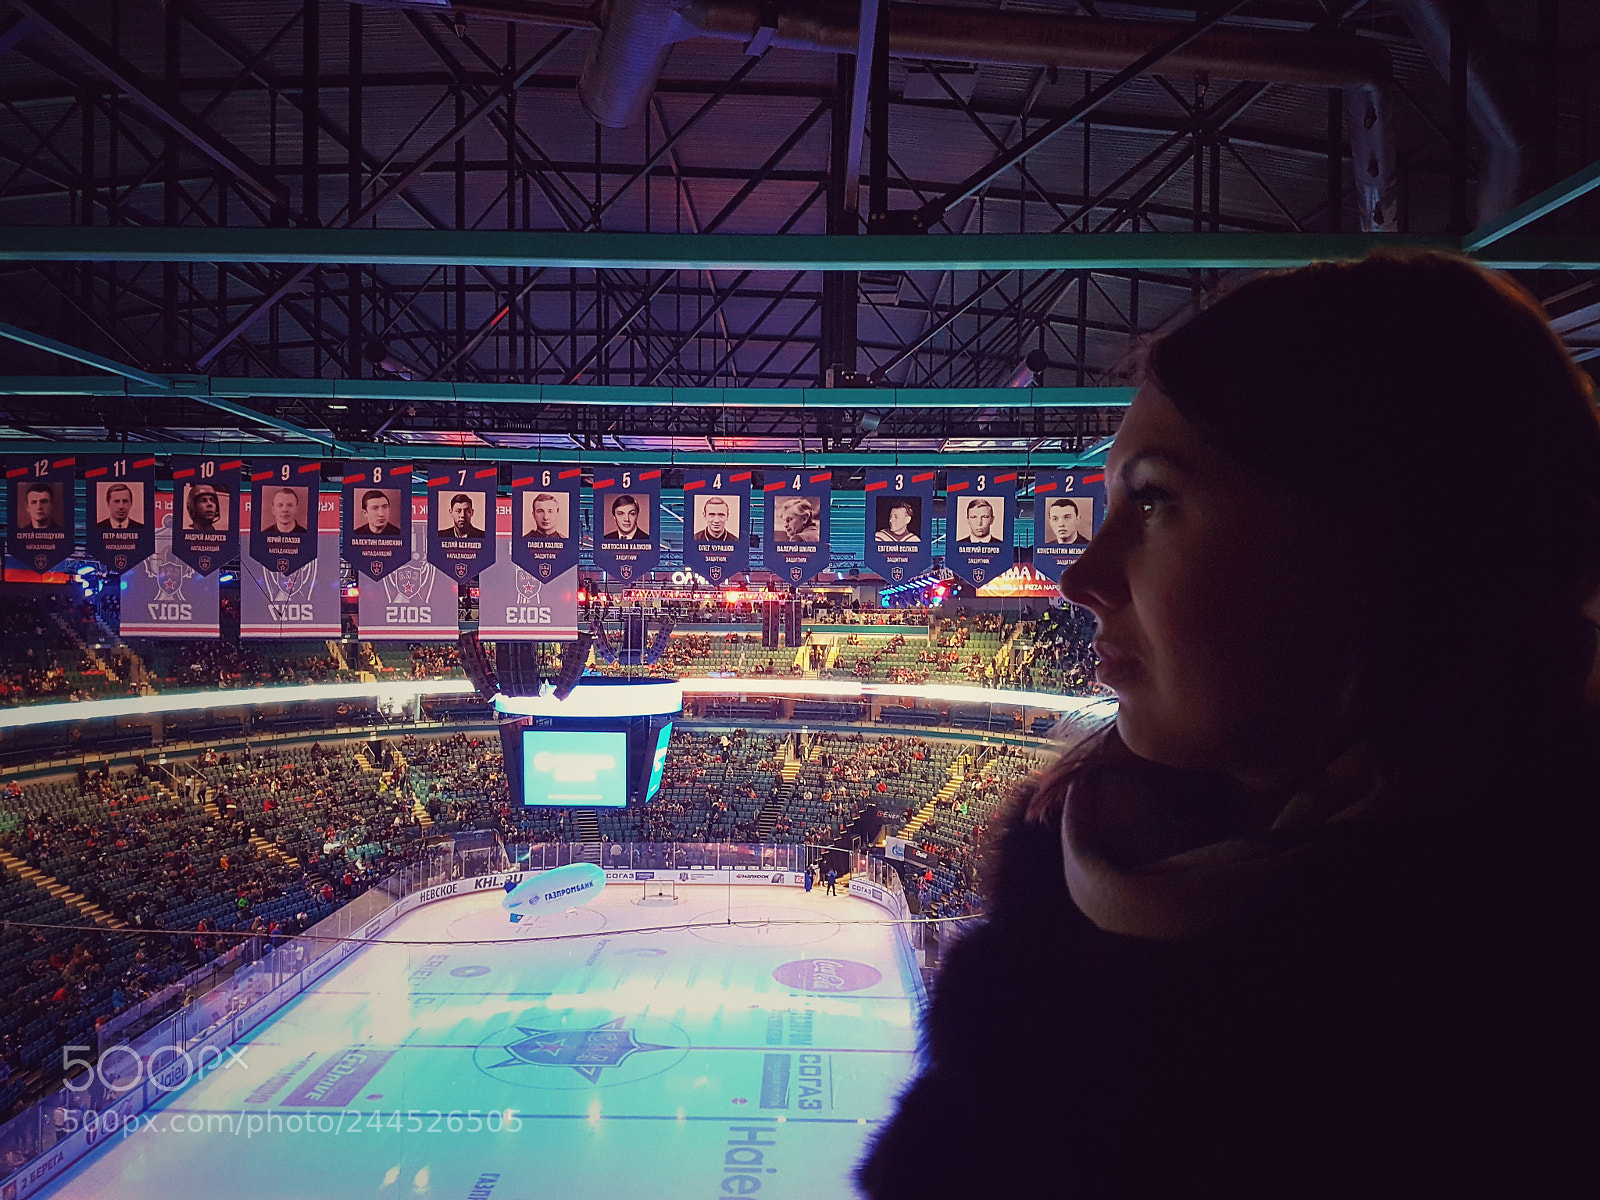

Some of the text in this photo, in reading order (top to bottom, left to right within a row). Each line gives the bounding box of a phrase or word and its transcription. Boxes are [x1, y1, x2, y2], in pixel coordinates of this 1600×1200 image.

[34, 459, 49, 477] 12
[113, 460, 126, 477] 11
[200, 461, 215, 478] 10
[281, 464, 290, 482] 9
[373, 466, 382, 483] 8
[458, 469, 467, 487] 7
[541, 470, 551, 487] 6
[622, 471, 632, 488] 5
[712, 473, 722, 490] 4
[792, 474, 801, 491] 4
[895, 475, 904, 491] 3
[977, 475, 986, 492] 3
[1065, 475, 1074, 492] 2
[420, 883, 458, 903] НЕВСКОЕ
[544, 880, 595, 901] ГАЗПРОМБАНК
[798, 1054, 823, 1110] СОГАЗ
